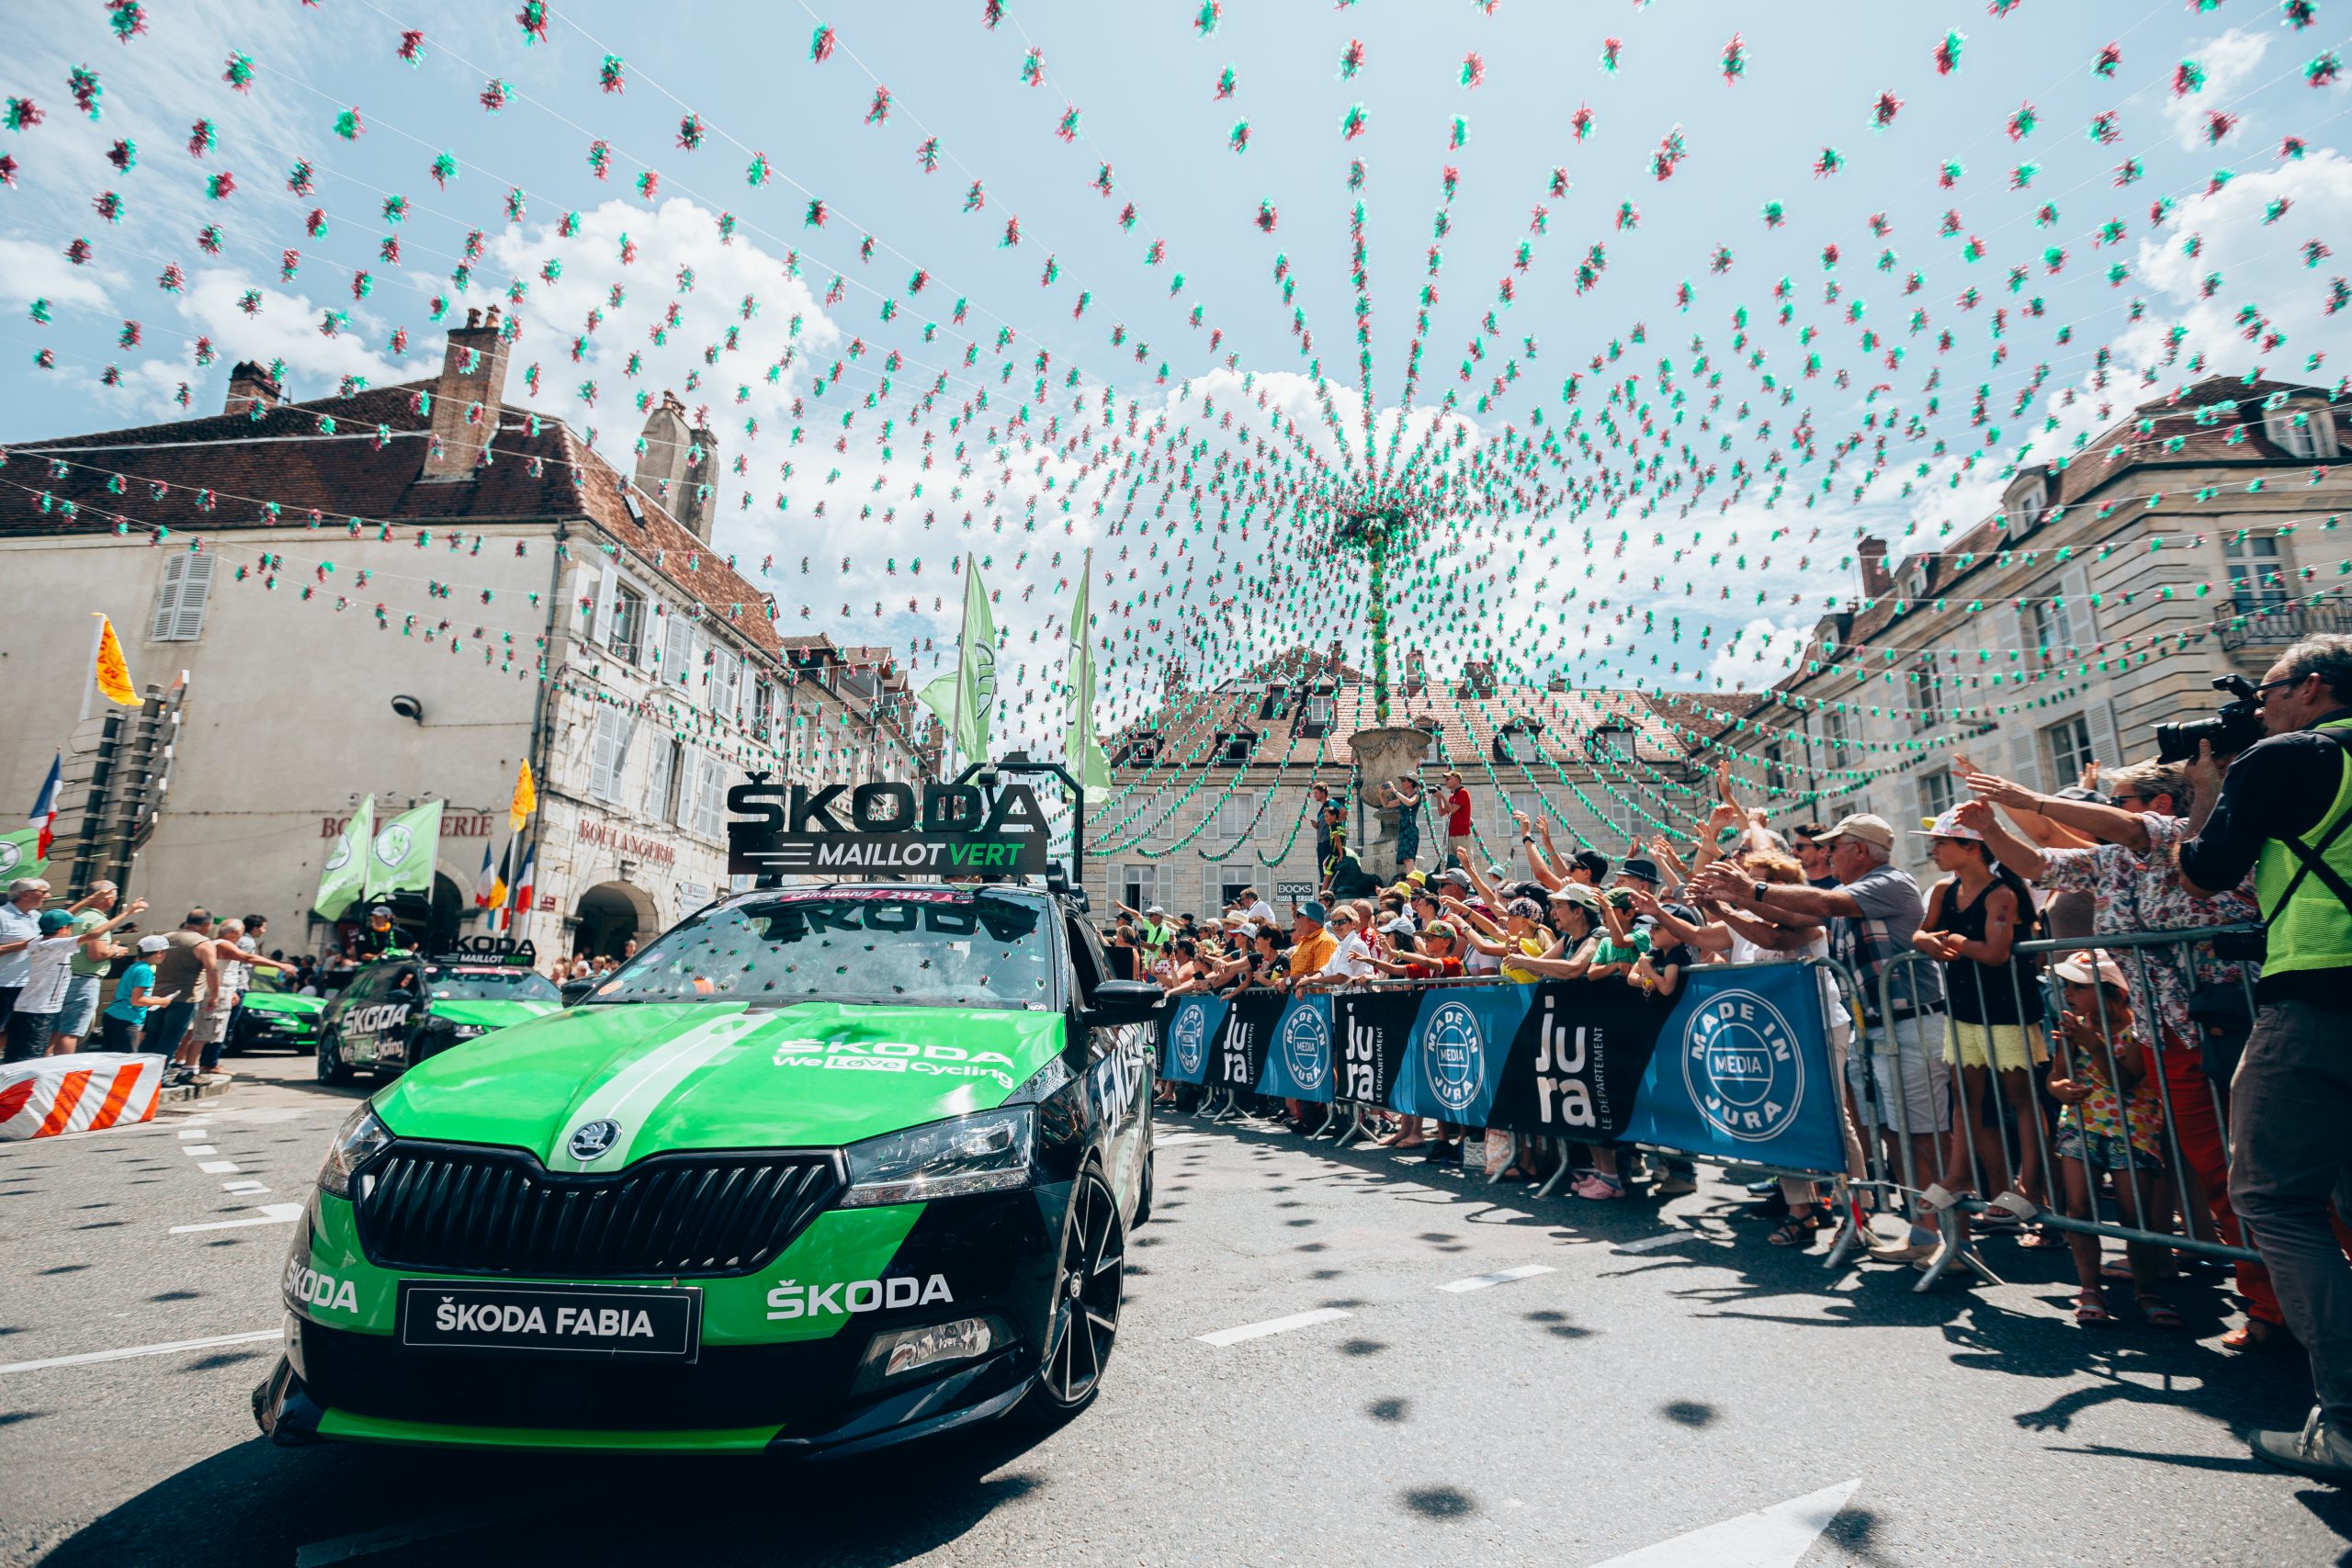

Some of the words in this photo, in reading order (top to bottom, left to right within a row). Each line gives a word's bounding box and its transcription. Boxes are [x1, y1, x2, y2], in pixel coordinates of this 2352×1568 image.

[727, 772, 1051, 832] ŠKODA
[580, 819, 675, 864] BOULANGERIE
[817, 843, 945, 866] MAILLOT
[948, 843, 1025, 866] VERT
[791, 891, 873, 899] CARAVANE
[1278, 885, 1312, 894] DOCKS
[448, 935, 536, 956] KODA
[459, 953, 503, 964] MAILLOT
[505, 955, 529, 964] VERT
[1287, 1012, 1312, 1043] MADE
[1316, 1024, 1325, 1045] IN
[1428, 1011, 1463, 1052] MADE
[1465, 1025, 1478, 1054] IN
[1691, 1002, 1754, 1060] MADE
[1763, 1022, 1791, 1062] IN
[776, 1038, 1015, 1068] ŠKODA
[1296, 1042, 1315, 1053] MEDIA
[1441, 1048, 1464, 1061] MEDIA
[773, 1056, 823, 1066] We
[830, 1057, 902, 1070] Love
[910, 1062, 1014, 1089] Cycling
[1293, 1064, 1320, 1082] JURA
[1714, 1055, 1763, 1073] MEDIA
[1249, 1077, 1254, 1085] LE
[1435, 1077, 1473, 1100] JURA
[1376, 1093, 1383, 1102] LE
[1705, 1095, 1782, 1129] JURA
[1602, 1118, 1612, 1130] LE
[283, 1254, 358, 1314] ŠKODA
[766, 1273, 954, 1320] ŠKODA
[436, 1297, 547, 1335] ŠKODA
[556, 1307, 654, 1337] FABIA
